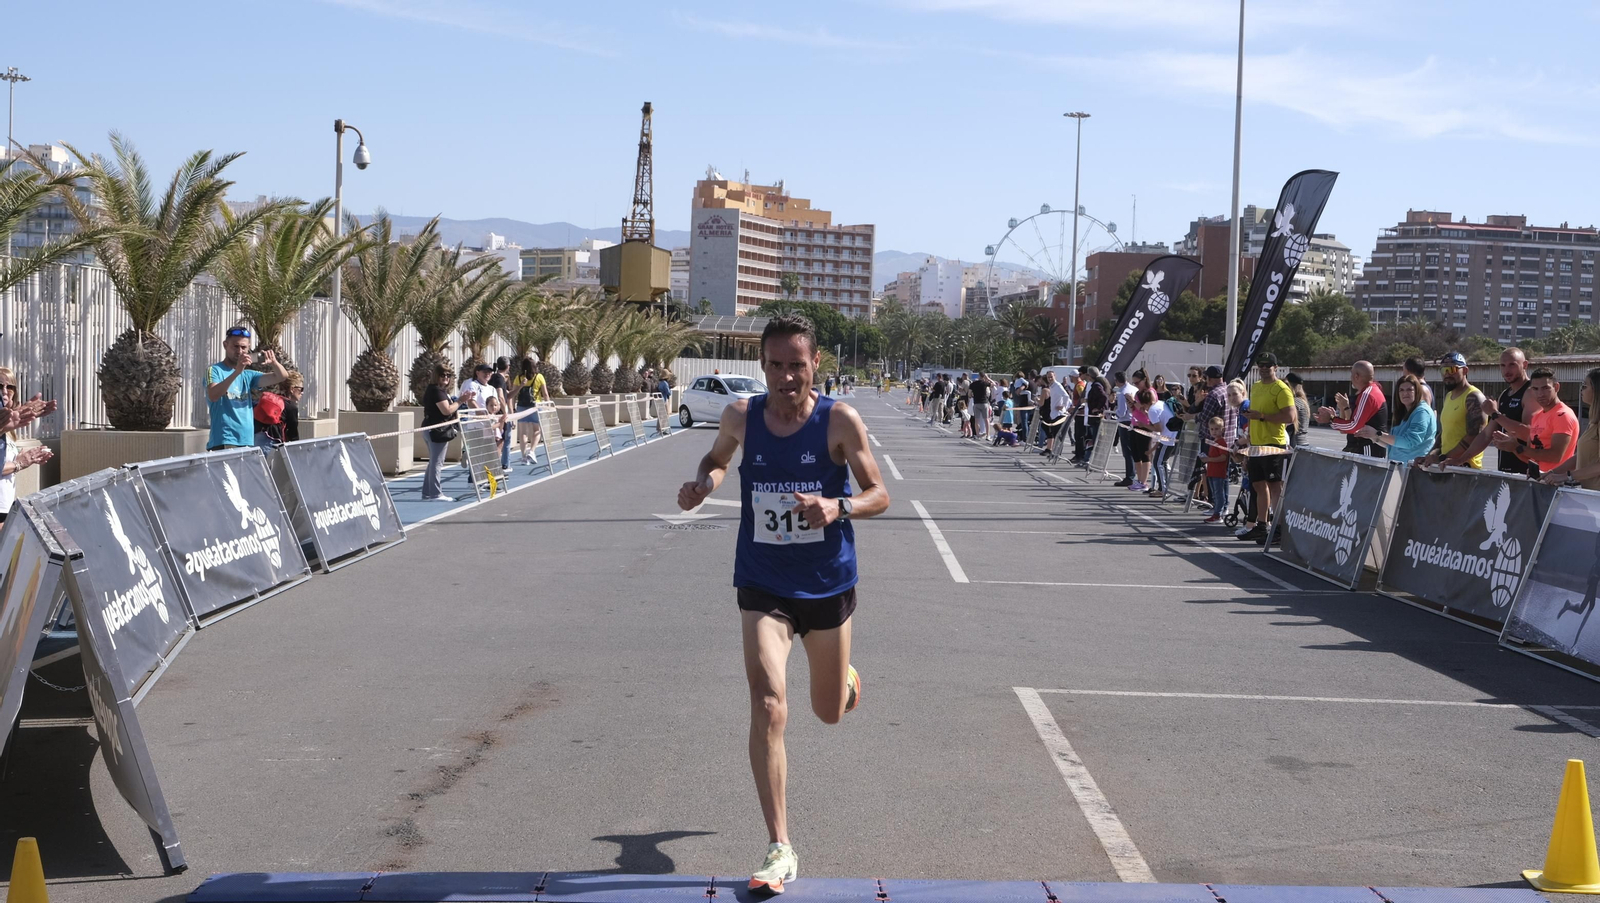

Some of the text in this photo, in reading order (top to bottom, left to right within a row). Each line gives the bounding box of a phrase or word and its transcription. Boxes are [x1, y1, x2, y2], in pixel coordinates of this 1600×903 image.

[752, 480, 823, 493] TROTASIERRA
[313, 500, 366, 535] aquéatacamos
[764, 509, 811, 533] 315
[1285, 507, 1340, 543] aquéatacamos
[185, 532, 262, 582] aquéatacamos
[1404, 537, 1494, 580] aquéatacamos
